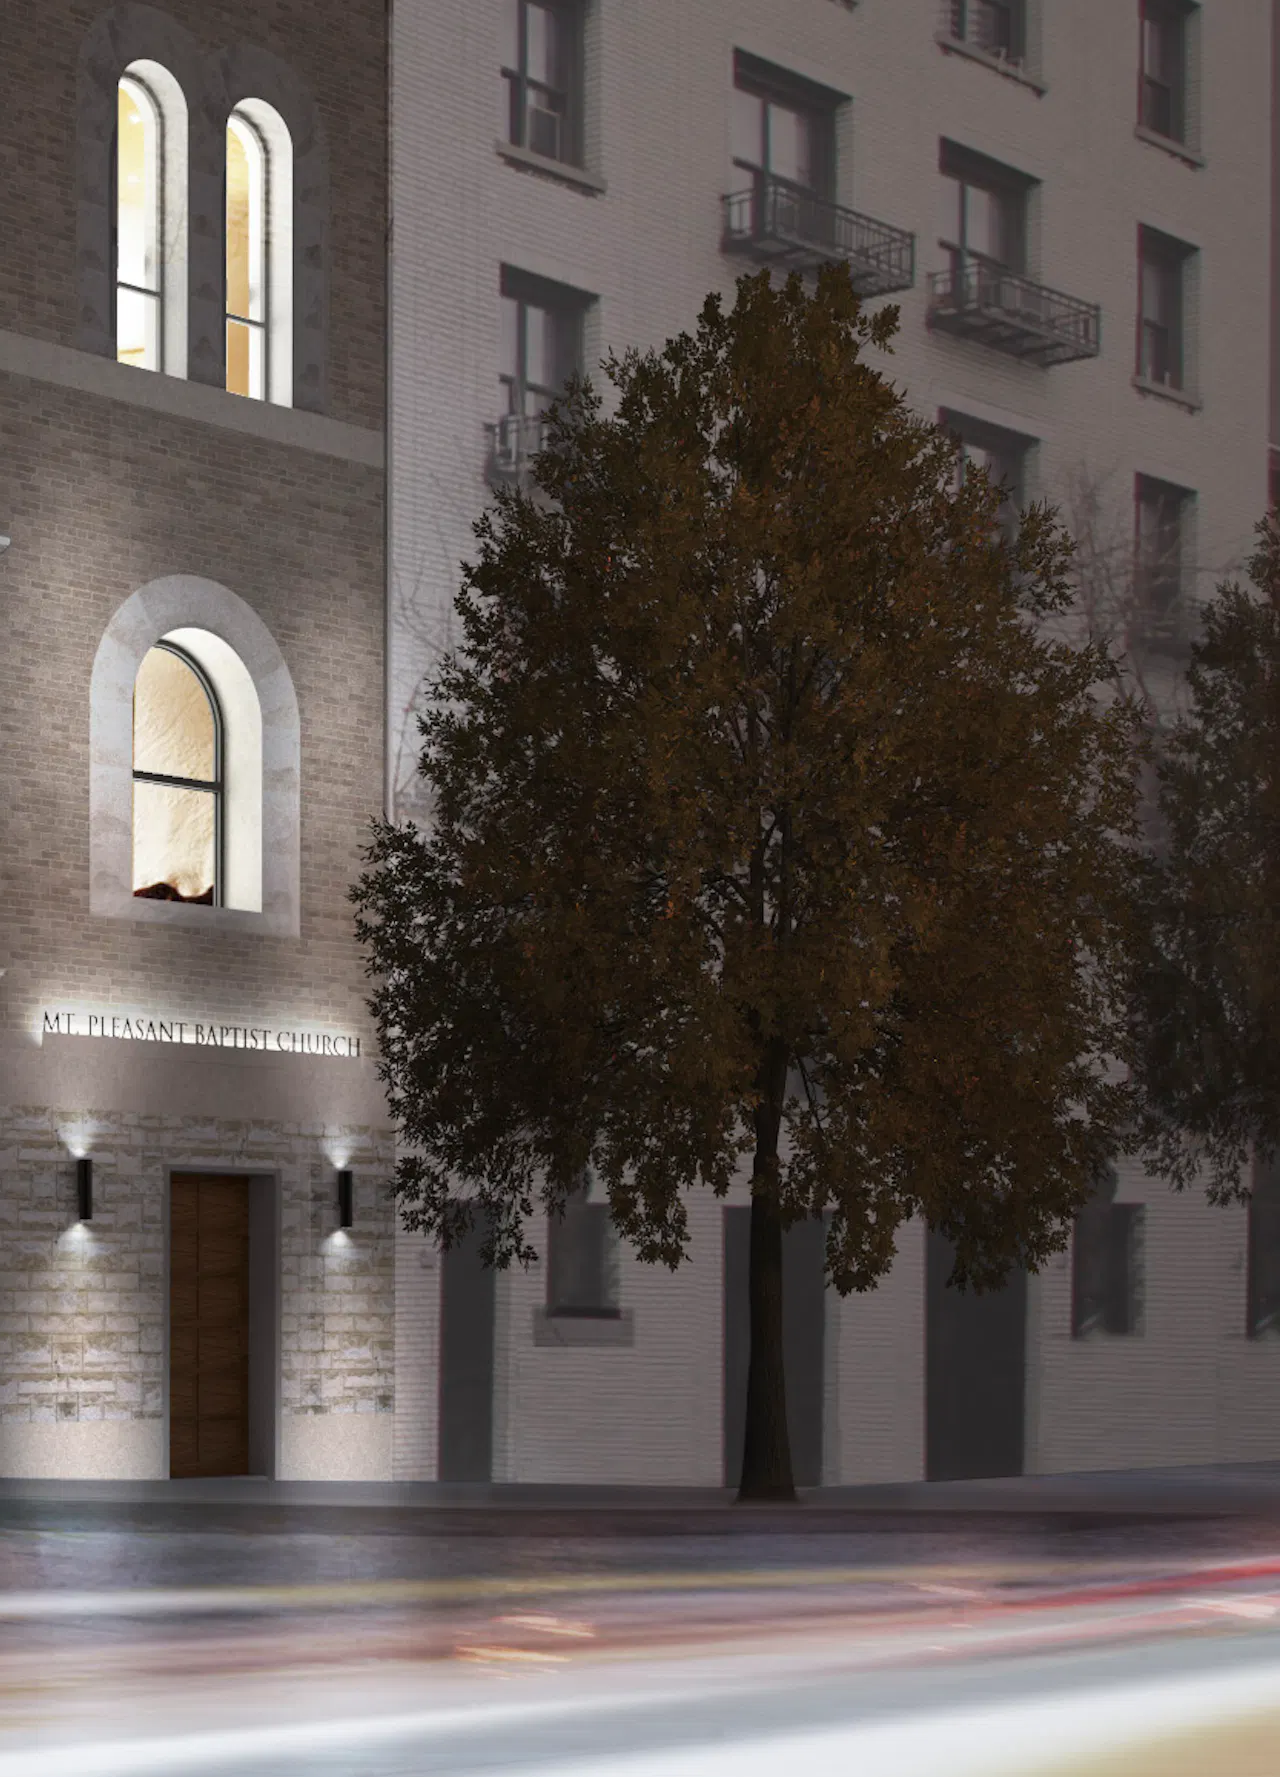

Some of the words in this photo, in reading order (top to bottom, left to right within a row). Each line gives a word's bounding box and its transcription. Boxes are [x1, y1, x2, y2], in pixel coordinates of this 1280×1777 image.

[42, 1009, 81, 1036] MT.
[88, 1014, 189, 1045] PLEASANT
[195, 1023, 272, 1051] BAPTIST
[276, 1031, 361, 1058] CHURCH
